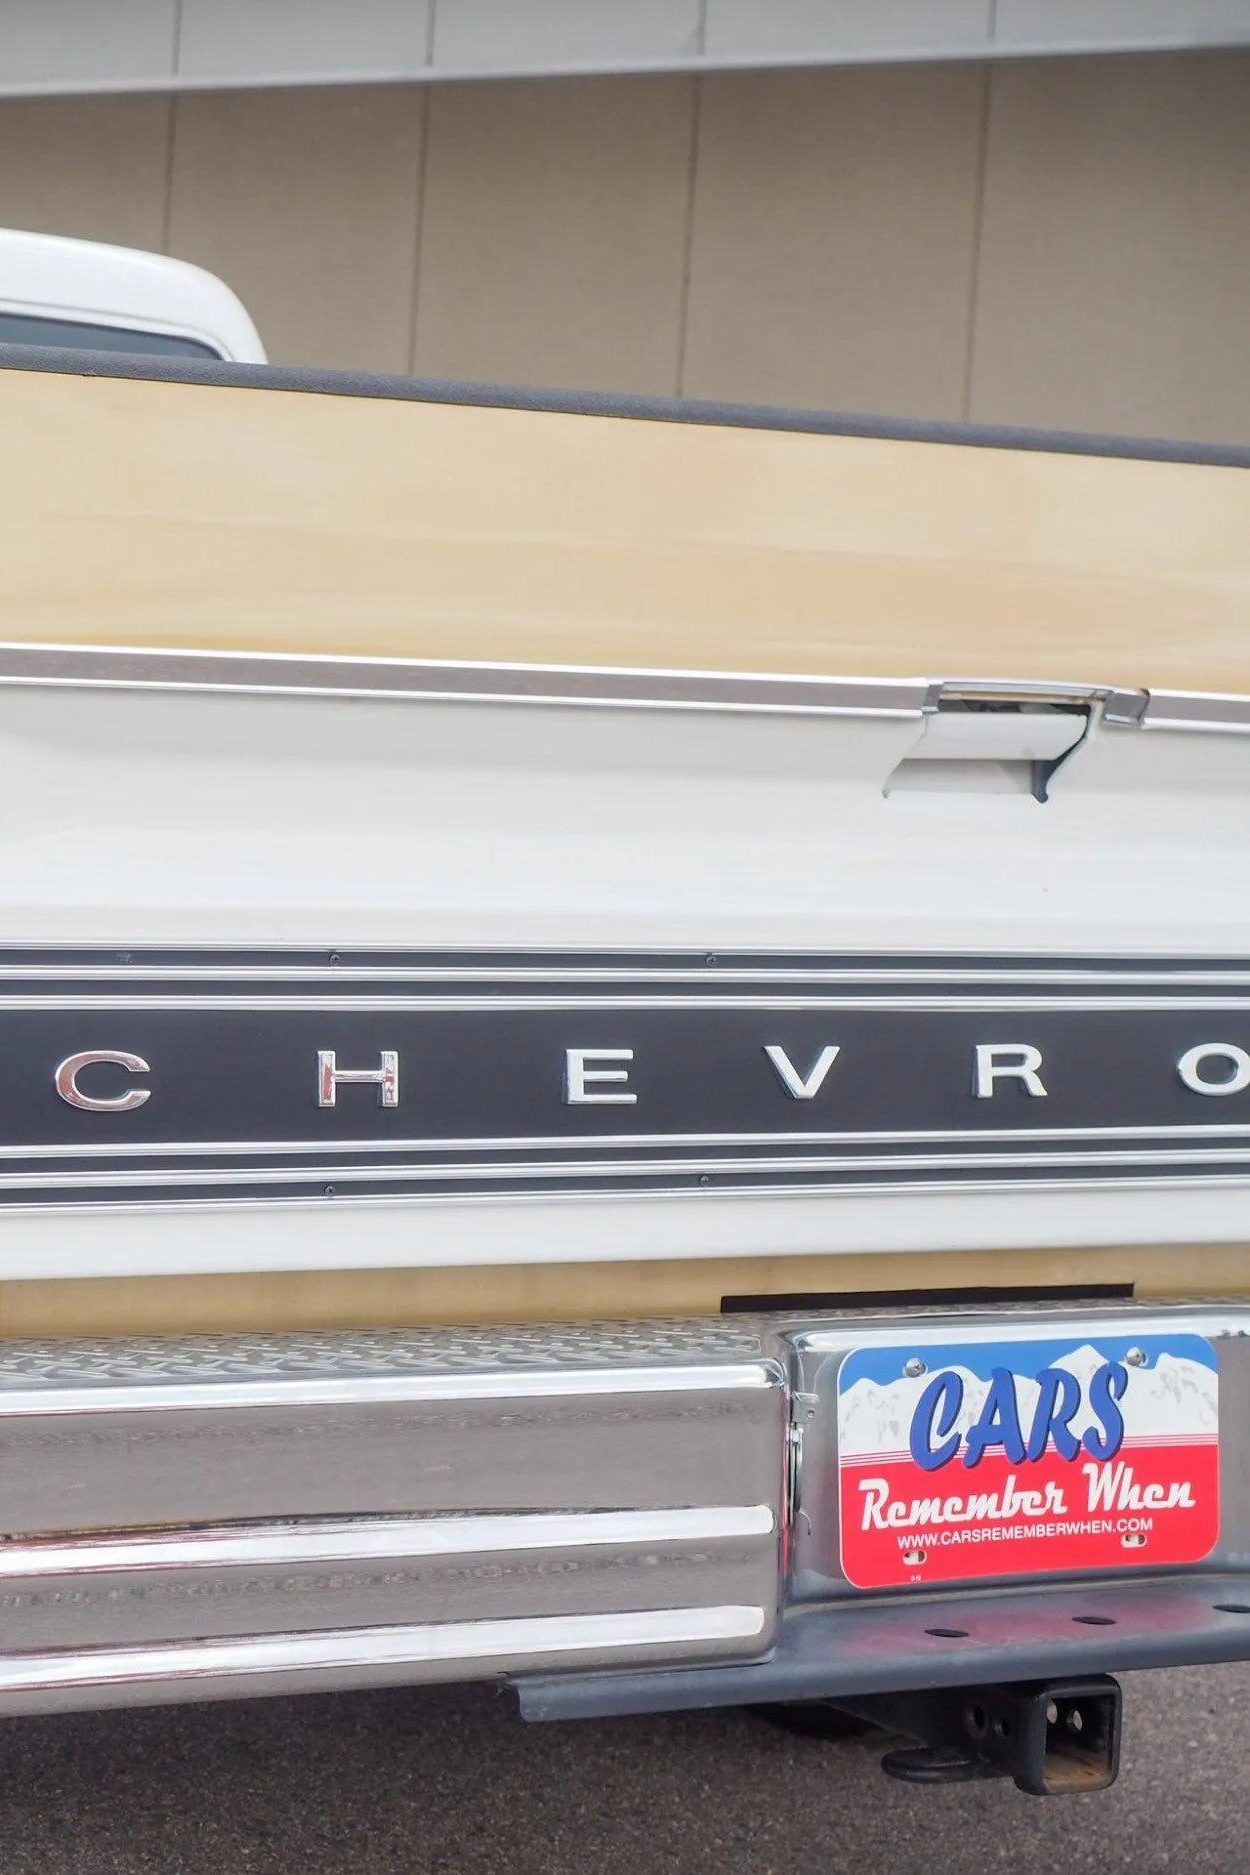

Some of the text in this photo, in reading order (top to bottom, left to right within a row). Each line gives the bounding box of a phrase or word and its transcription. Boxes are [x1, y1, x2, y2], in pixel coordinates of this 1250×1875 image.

[54, 1042, 1250, 1112] CHEVRO
[910, 1361, 1129, 1471] CARS
[858, 1461, 1196, 1531] Remember When
[898, 1517, 1153, 1550] WWW.CARSREMEMBERWHEN.COM
